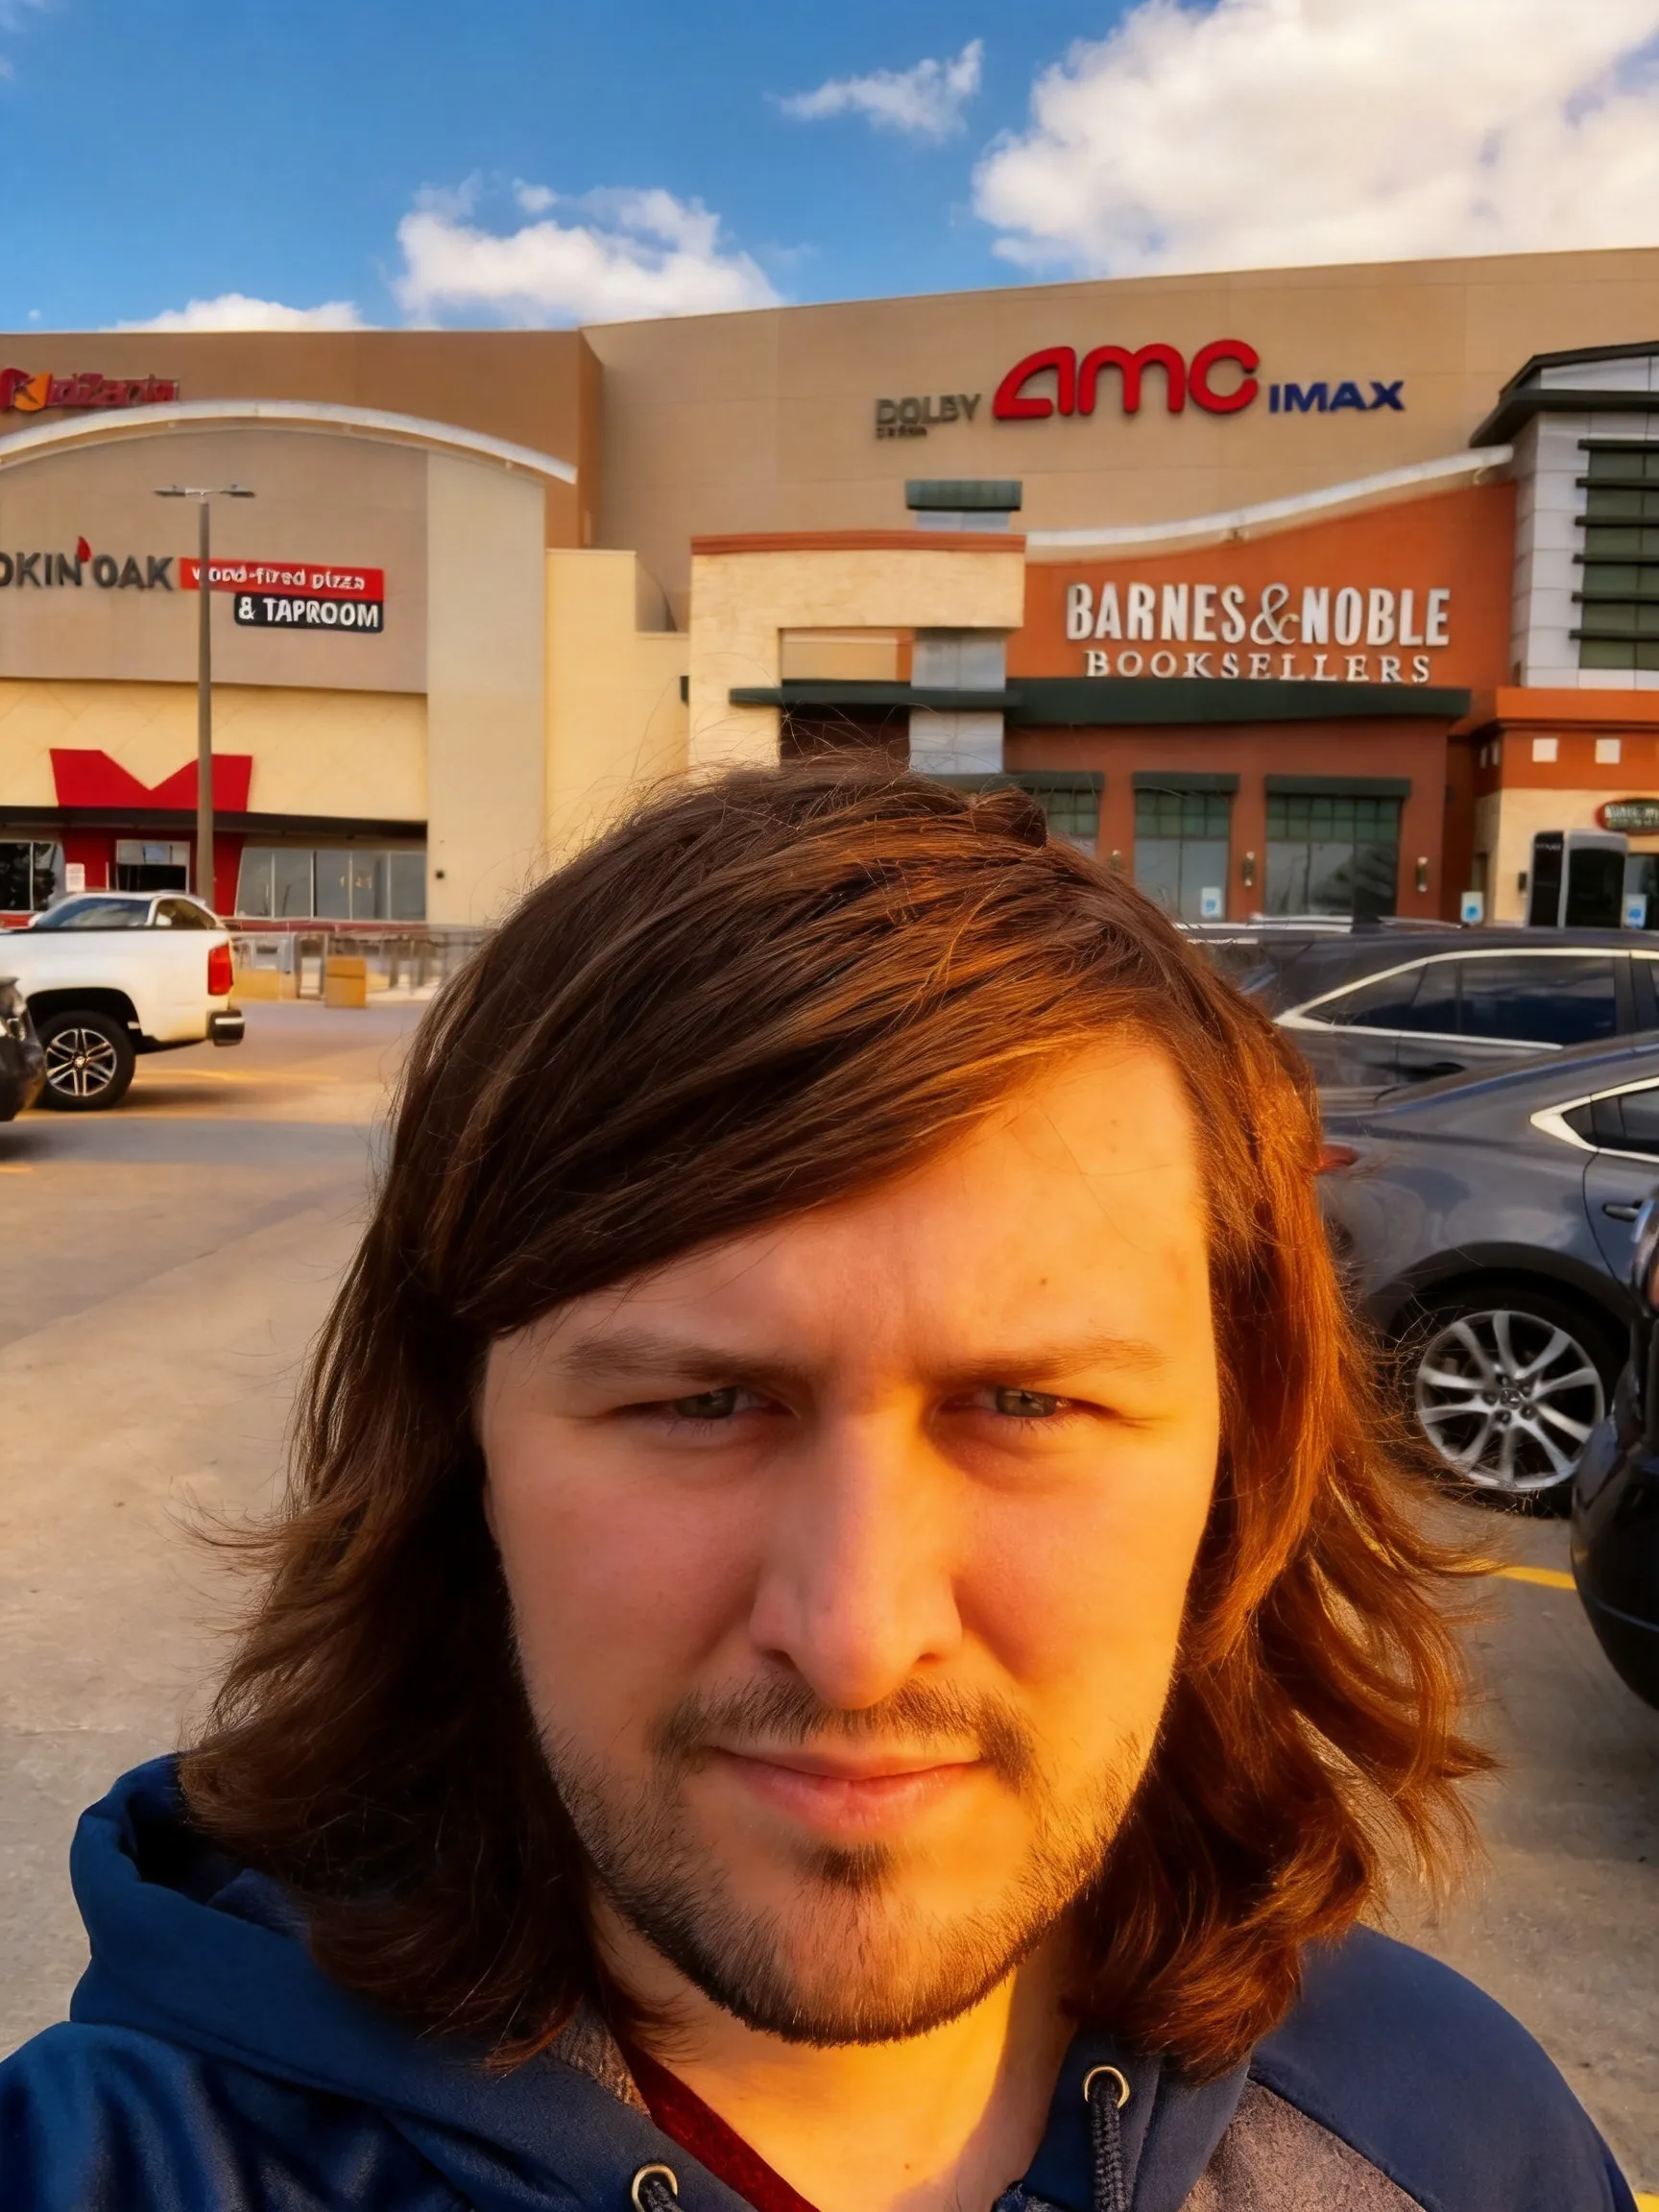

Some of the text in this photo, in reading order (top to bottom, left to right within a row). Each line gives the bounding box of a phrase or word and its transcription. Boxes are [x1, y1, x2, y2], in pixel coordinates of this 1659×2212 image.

[877, 394, 981, 424] DOLBY
[1268, 380, 1406, 413] IMAX
[92, 555, 175, 592] OAK
[312, 570, 366, 590] pizza
[238, 596, 379, 629] & TAPROOM
[1085, 649, 1431, 684] BOOKSELLERS
